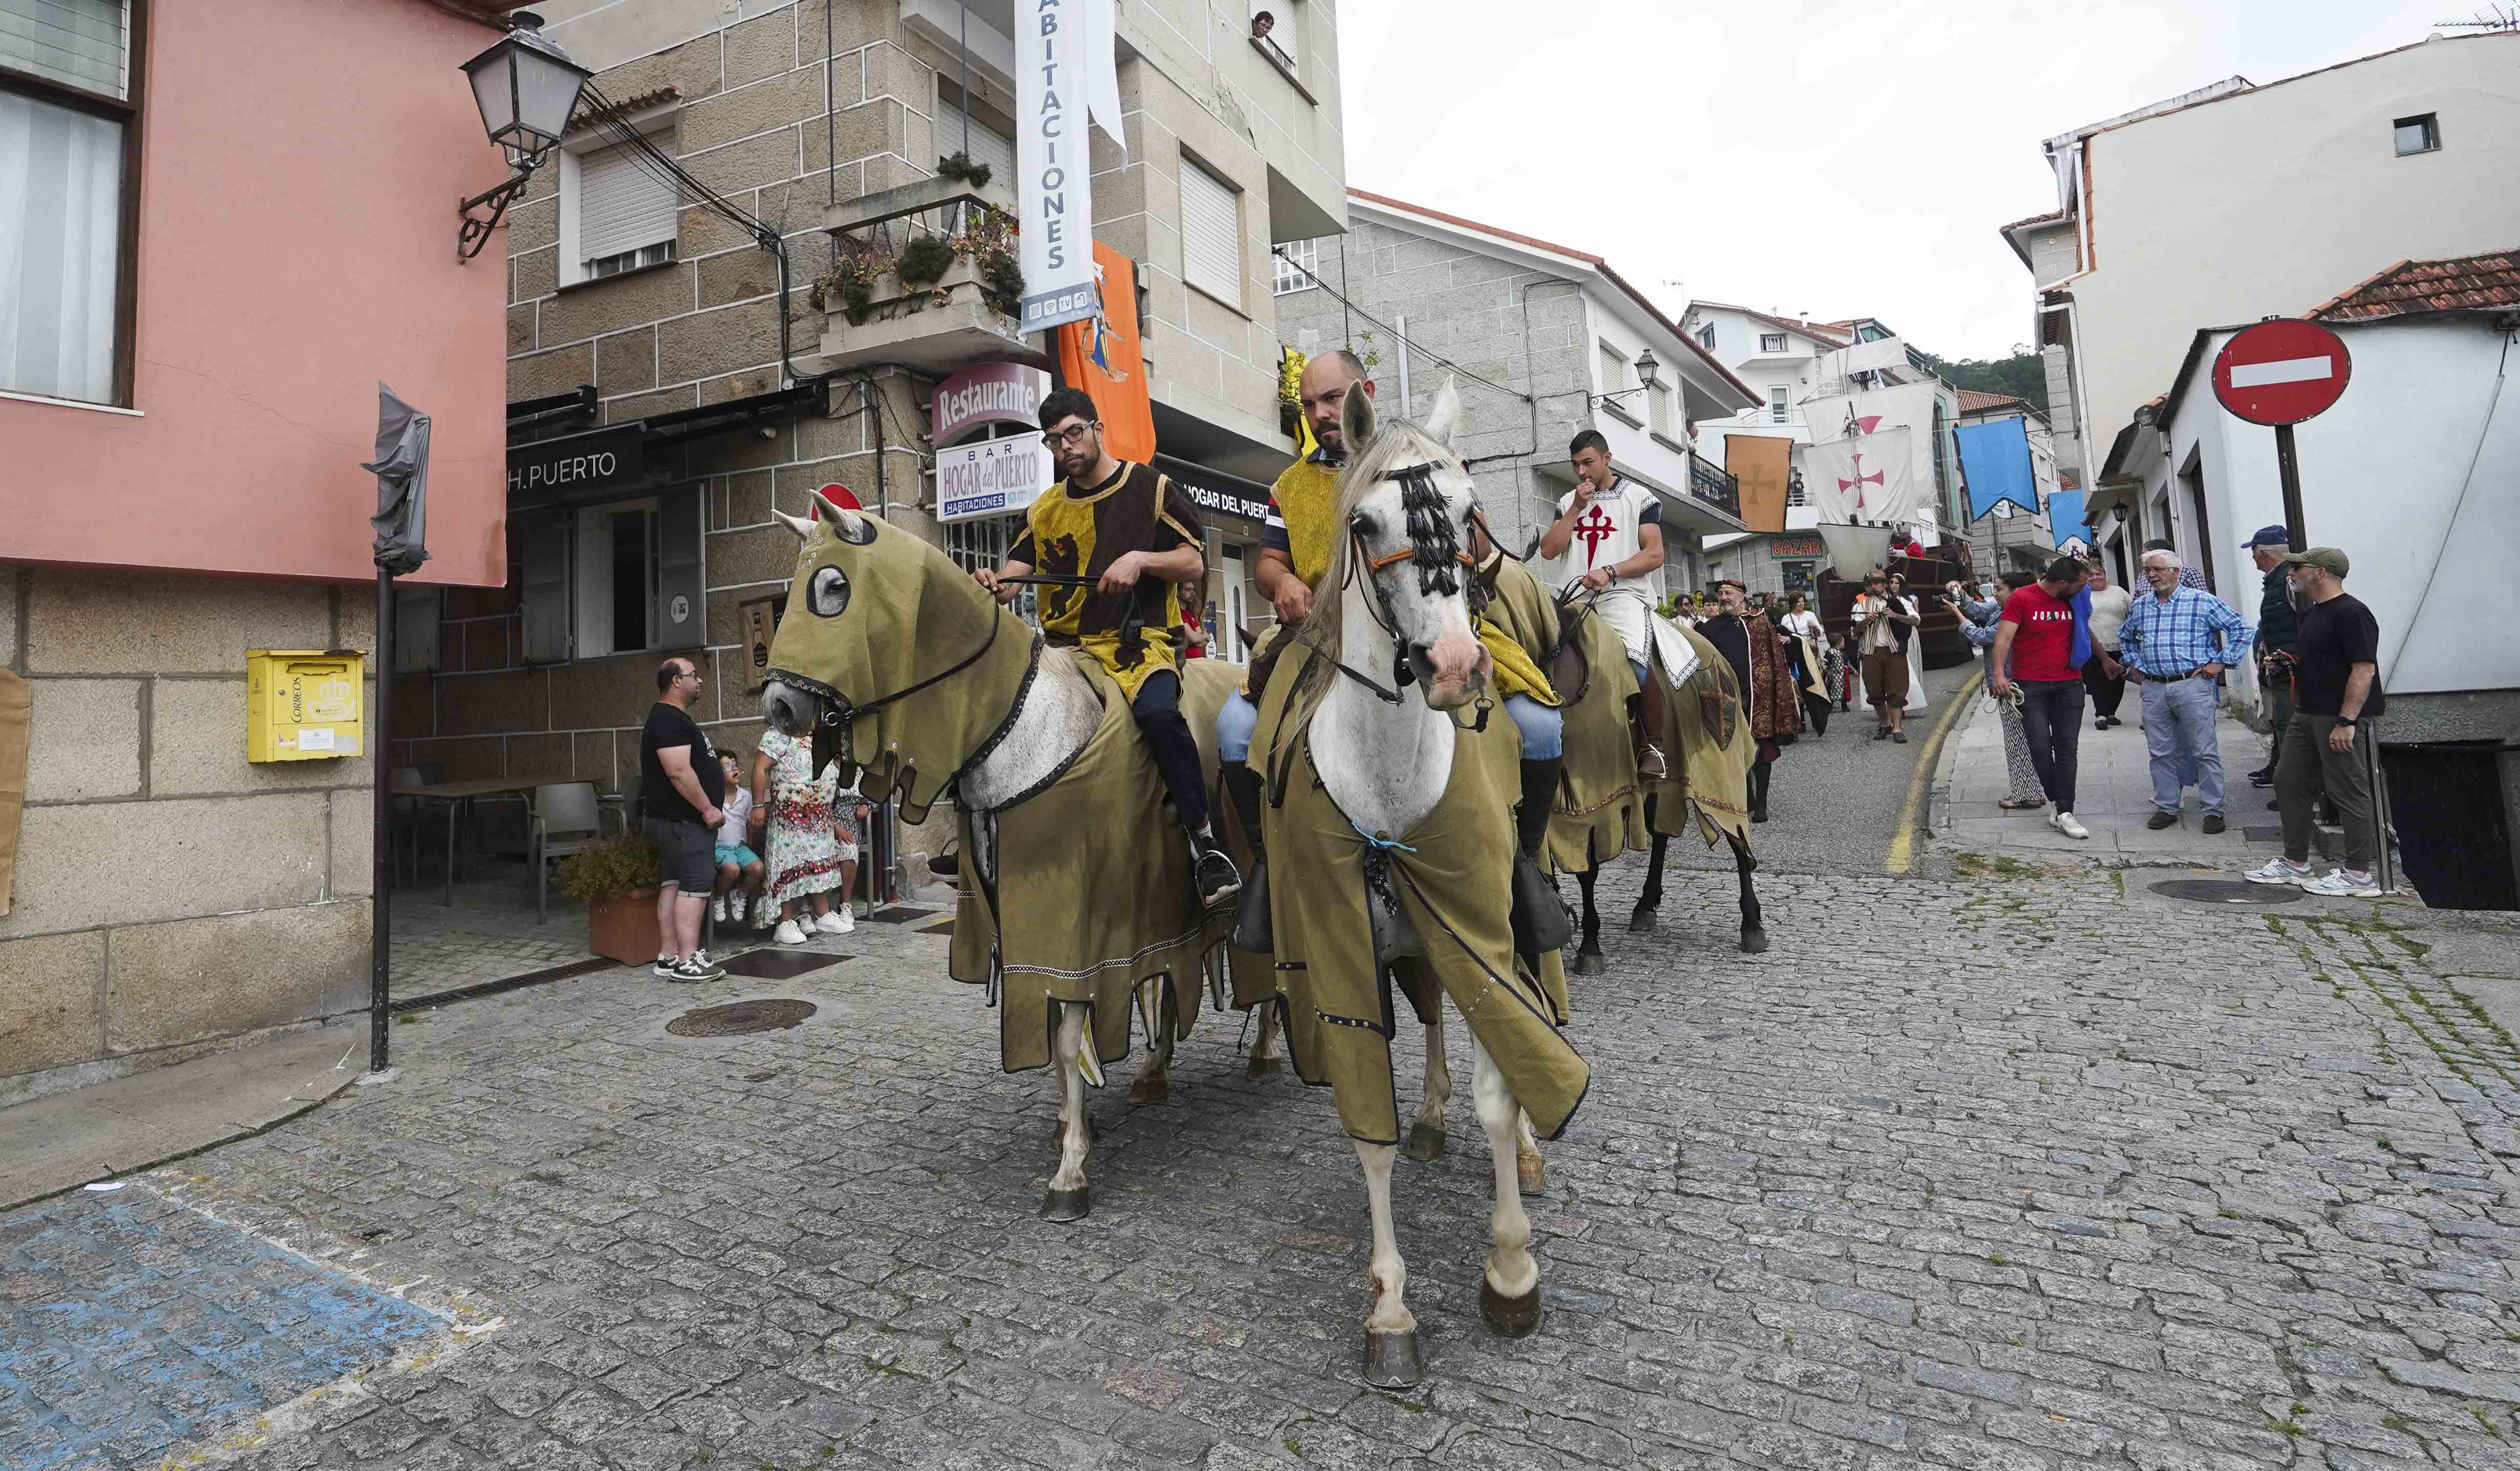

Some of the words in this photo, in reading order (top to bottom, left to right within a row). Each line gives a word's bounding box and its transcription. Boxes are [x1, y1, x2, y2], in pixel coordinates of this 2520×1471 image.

[1060, 299, 1070, 308] TV
[939, 377, 1035, 431] Restaurante
[968, 444, 1012, 461] BAR
[507, 452, 615, 492] H.PUERTO
[944, 462, 981, 498] HOGAR
[983, 463, 994, 488] del
[995, 452, 1037, 490] PUERTO
[947, 495, 1003, 514] HABITACIONES
[1184, 484, 1220, 508] OGAR
[1222, 495, 1240, 513] DEL
[1772, 540, 1821, 557] BAZAR
[291, 677, 302, 723] CORREOS
